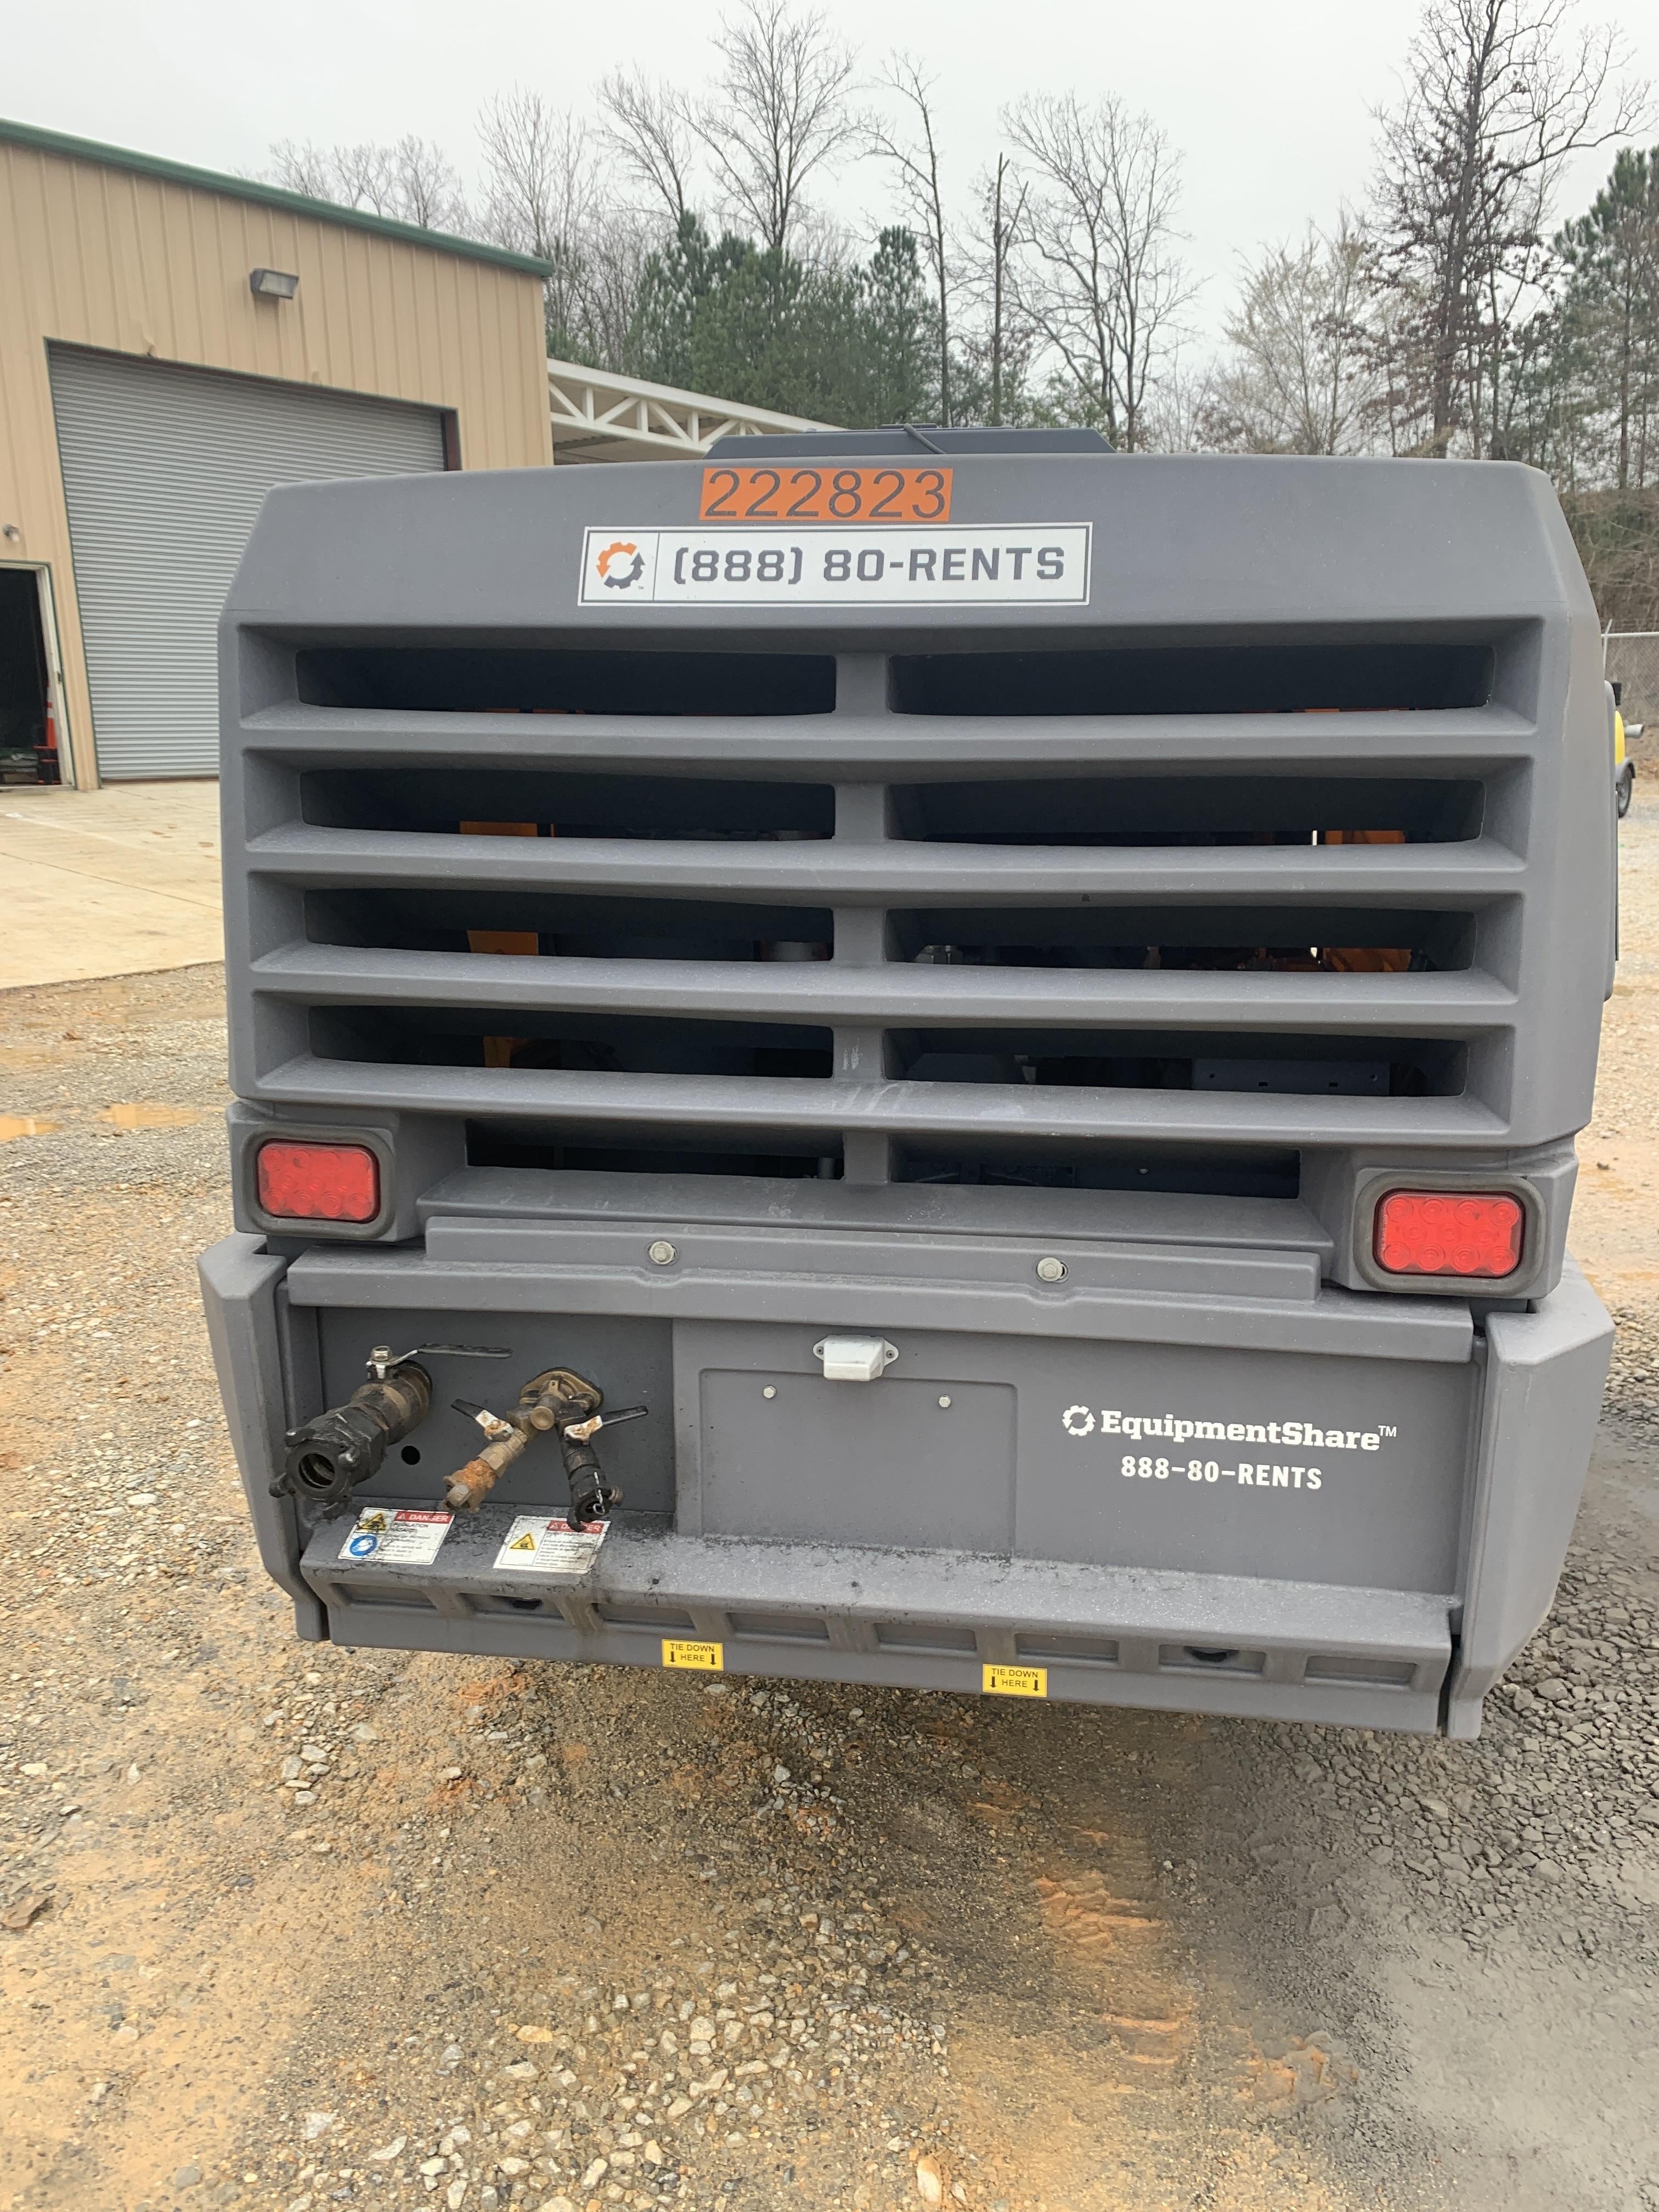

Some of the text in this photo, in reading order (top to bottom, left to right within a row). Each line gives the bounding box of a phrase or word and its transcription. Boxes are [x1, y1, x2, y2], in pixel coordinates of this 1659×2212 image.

[705, 470, 945, 518] 222823
[674, 546, 1065, 585] (888) 80-RENTS
[1121, 1455, 1323, 1490] 888-80-RENTS
[686, 1644, 715, 1652] DOWN
[680, 1654, 705, 1662] HERE
[991, 1668, 1039, 1678] TIE DOWN
[1002, 1679, 1028, 1688] HERE
